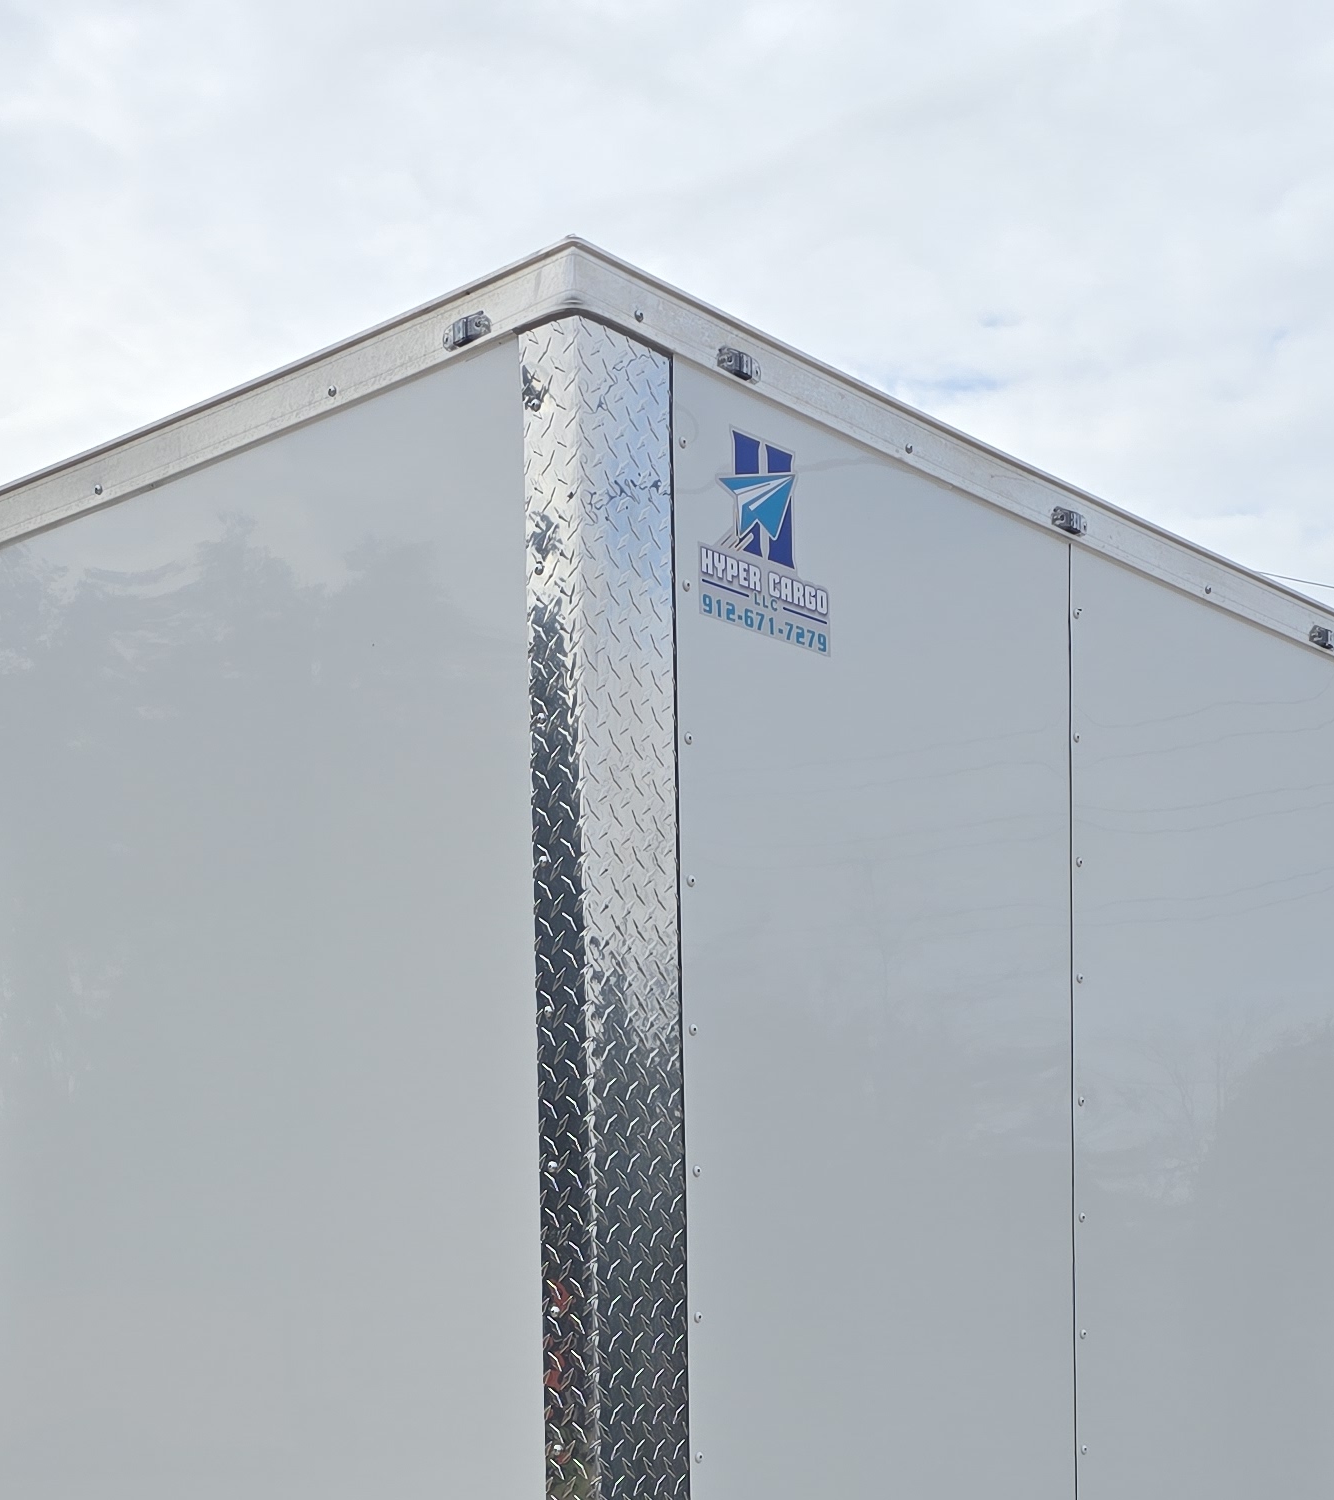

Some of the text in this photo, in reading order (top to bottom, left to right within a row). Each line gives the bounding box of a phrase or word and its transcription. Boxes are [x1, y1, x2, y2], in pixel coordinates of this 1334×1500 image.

[700, 546, 829, 616] HYPER CARGO
[753, 591, 778, 613] LLC
[701, 592, 828, 654] 912-671-7279
